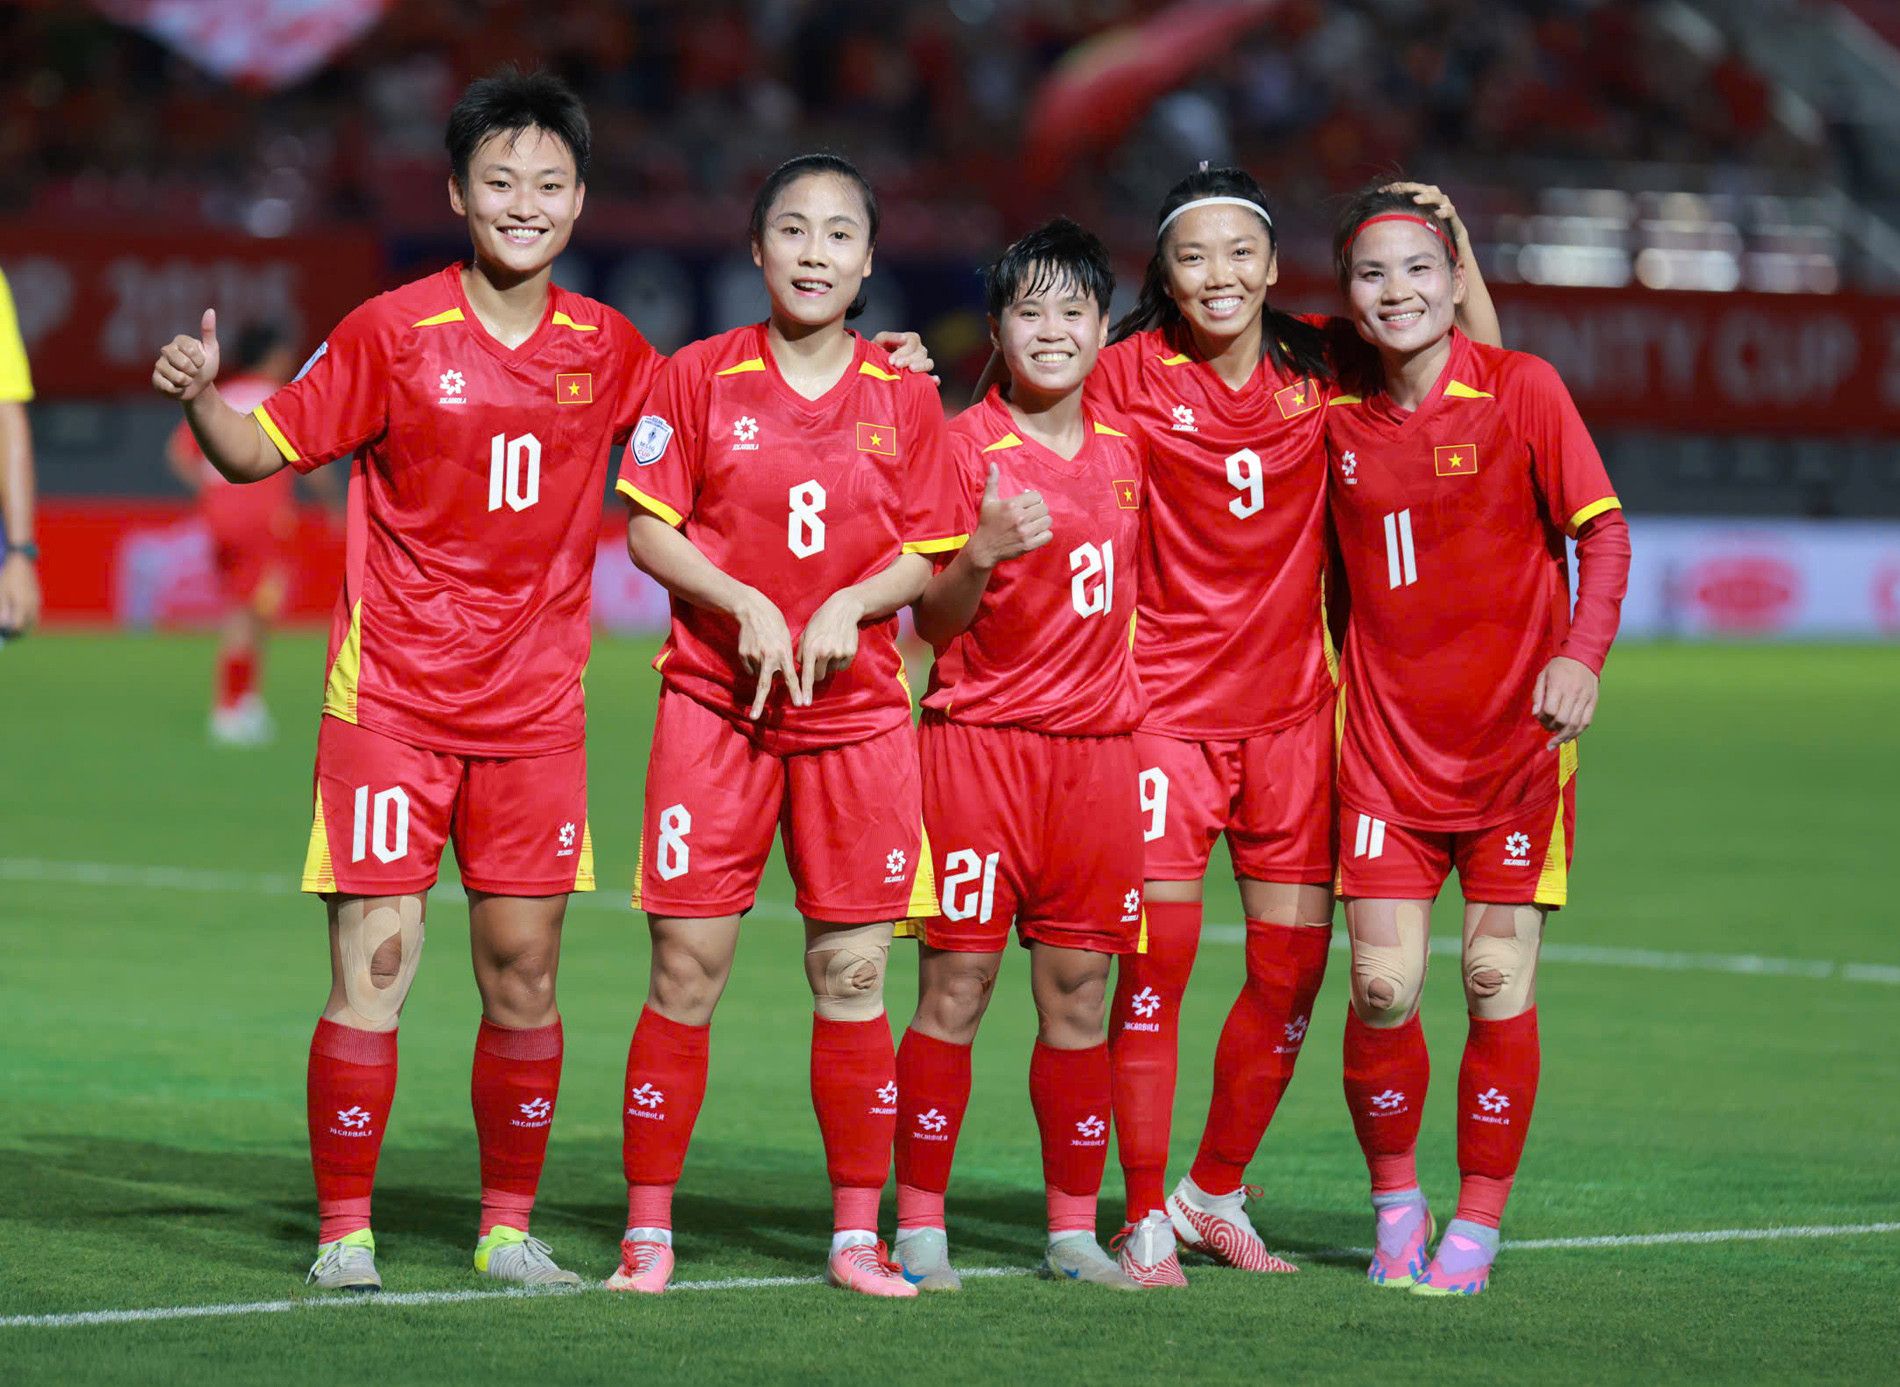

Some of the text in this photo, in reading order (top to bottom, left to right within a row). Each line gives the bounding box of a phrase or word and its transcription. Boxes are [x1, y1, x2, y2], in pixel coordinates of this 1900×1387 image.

[488, 433, 541, 512] 10
[1225, 448, 1263, 519] 9
[787, 480, 826, 559] 8
[1384, 509, 1417, 589] 11
[1070, 539, 1114, 618] 21
[352, 785, 410, 863] 10
[656, 804, 691, 881] 8
[1139, 767, 1169, 842] 9
[1354, 813, 1387, 860] 11
[942, 849, 999, 923] 21
